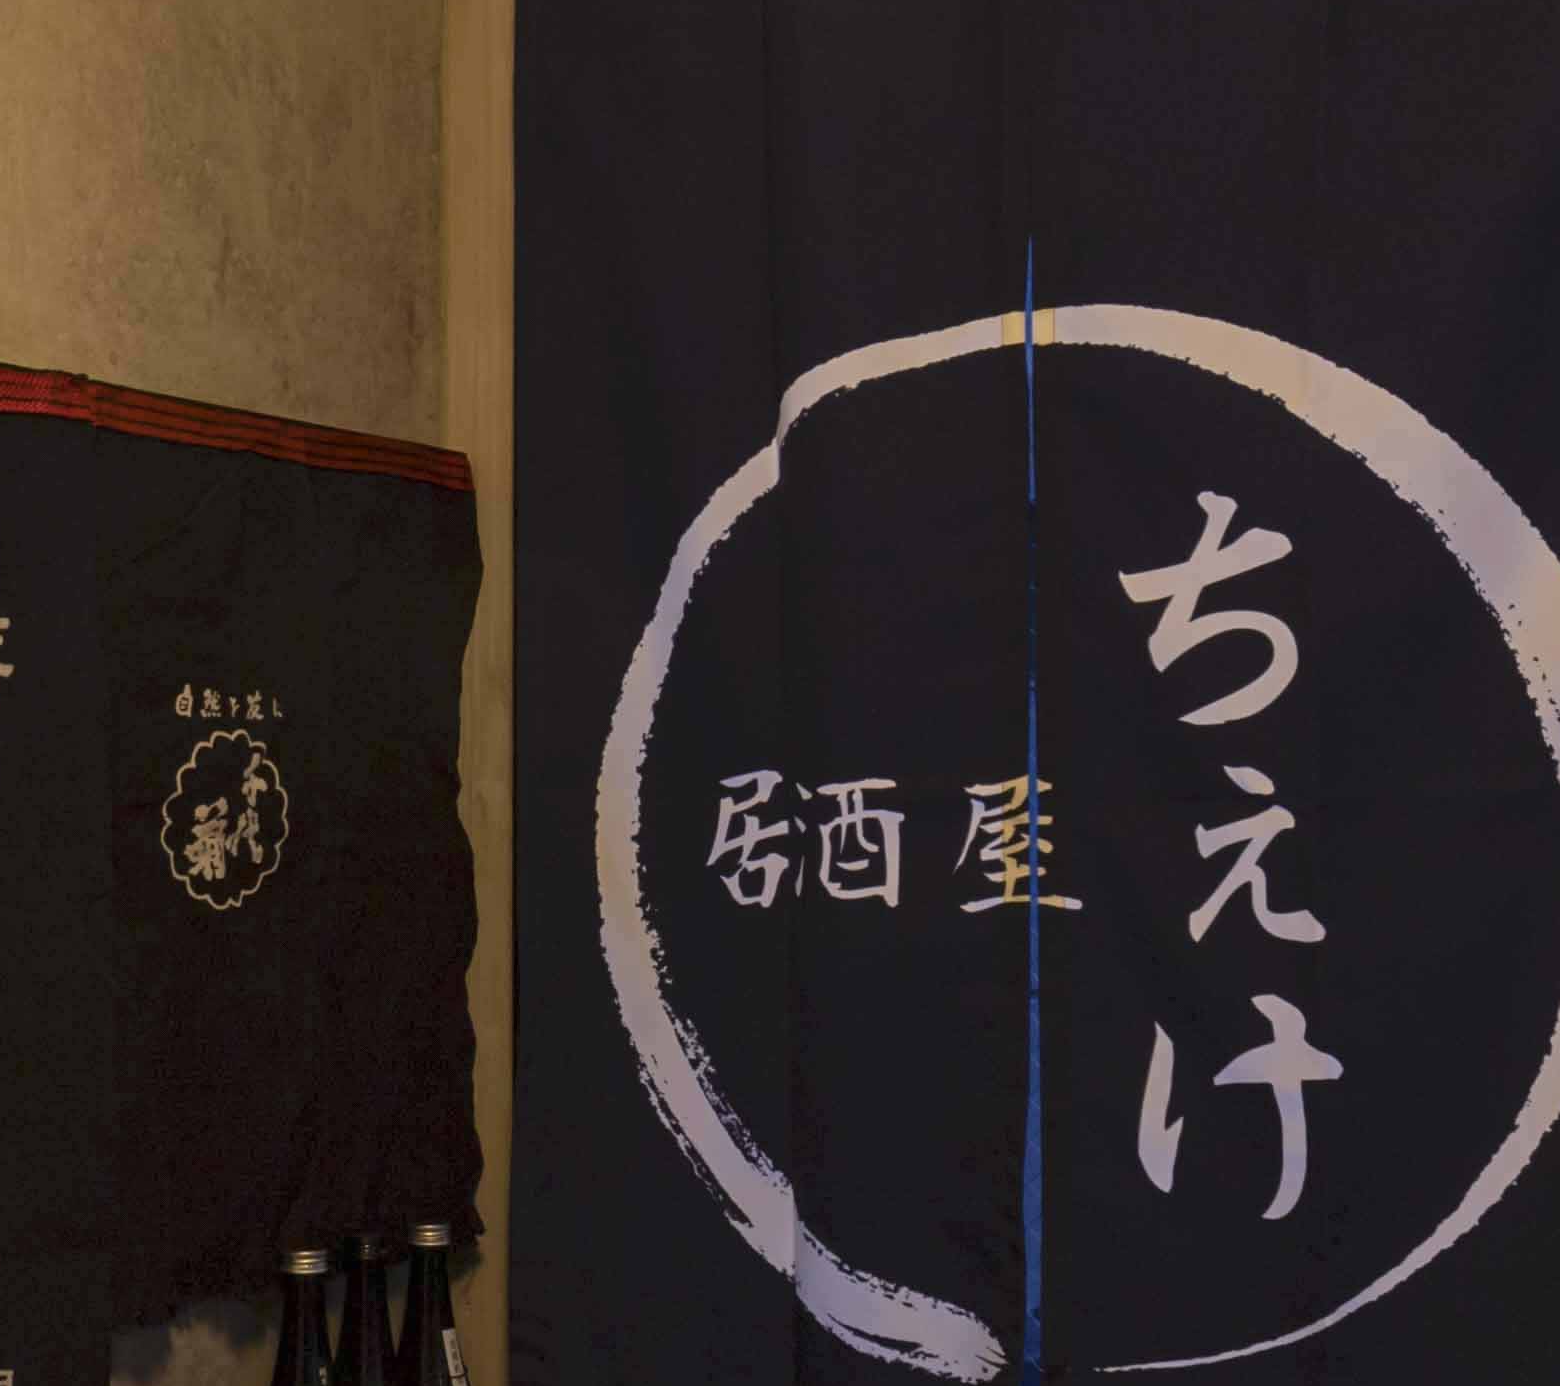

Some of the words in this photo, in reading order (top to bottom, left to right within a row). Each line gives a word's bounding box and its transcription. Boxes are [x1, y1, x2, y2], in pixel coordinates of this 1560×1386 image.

[705, 768, 1084, 914] 居酒屋
[1119, 490, 1345, 1220] ちえけ
